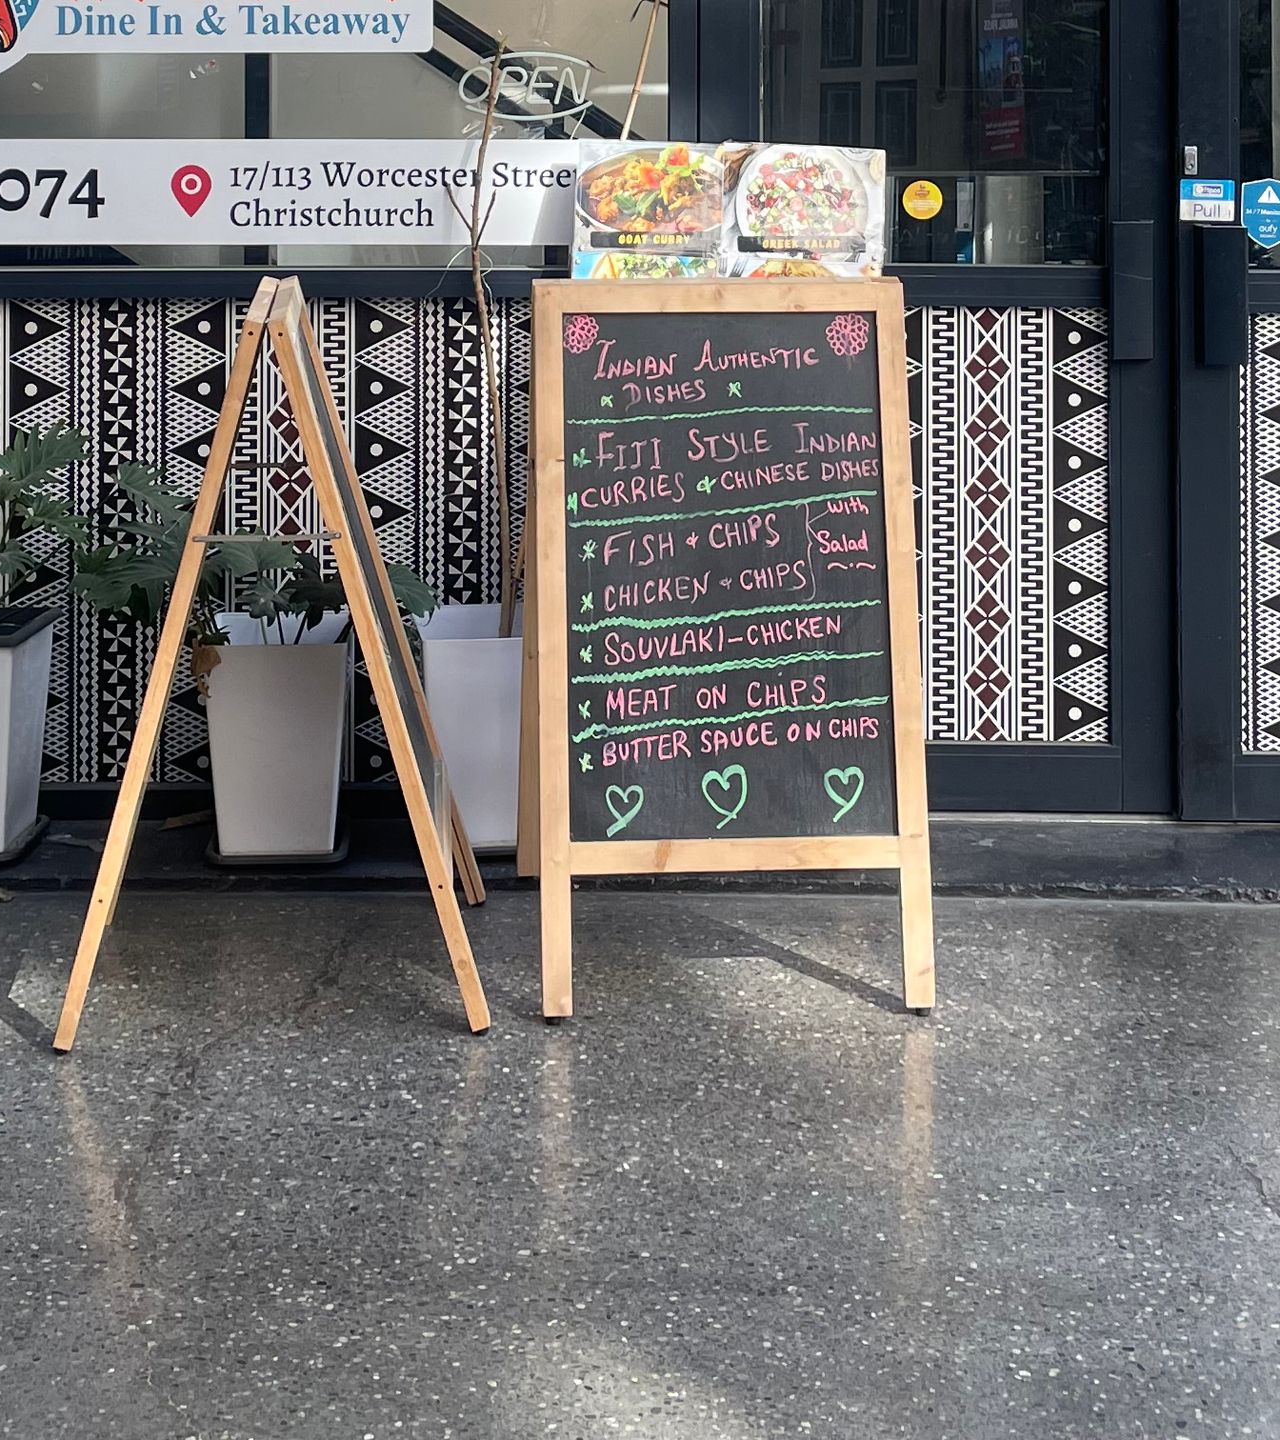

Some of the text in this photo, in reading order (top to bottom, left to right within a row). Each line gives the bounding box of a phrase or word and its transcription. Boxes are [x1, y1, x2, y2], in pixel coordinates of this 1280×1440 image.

[56, 3, 410, 43] Dine In & Takeaway
[458, 66, 590, 104] OPEN
[229, 161, 312, 192] 17/113
[492, 162, 577, 188] Stree
[229, 197, 434, 228] Christchurch
[1193, 204, 1220, 217] Pull
[619, 234, 690, 245] GOAT CURRY
[763, 239, 840, 249] GREEK SALAD
[593, 338, 819, 380] INDIAN AUTHENTIC
[622, 379, 706, 411] DISHES
[595, 422, 876, 470] FIJI STYLE INDIAN
[581, 471, 685, 509] CURRIES
[720, 461, 809, 491] CHINESE
[821, 459, 878, 481] DISHES
[827, 497, 869, 515] with
[603, 530, 674, 566] FISH
[708, 513, 780, 548] CHIPS
[817, 530, 868, 554] Salad
[603, 571, 711, 612] CHICKEN
[740, 561, 806, 592] CHIPS
[606, 675, 826, 719] MEAT ON CHIPS
[603, 717, 878, 767] BUTTER SAUCE ON CHIPS
